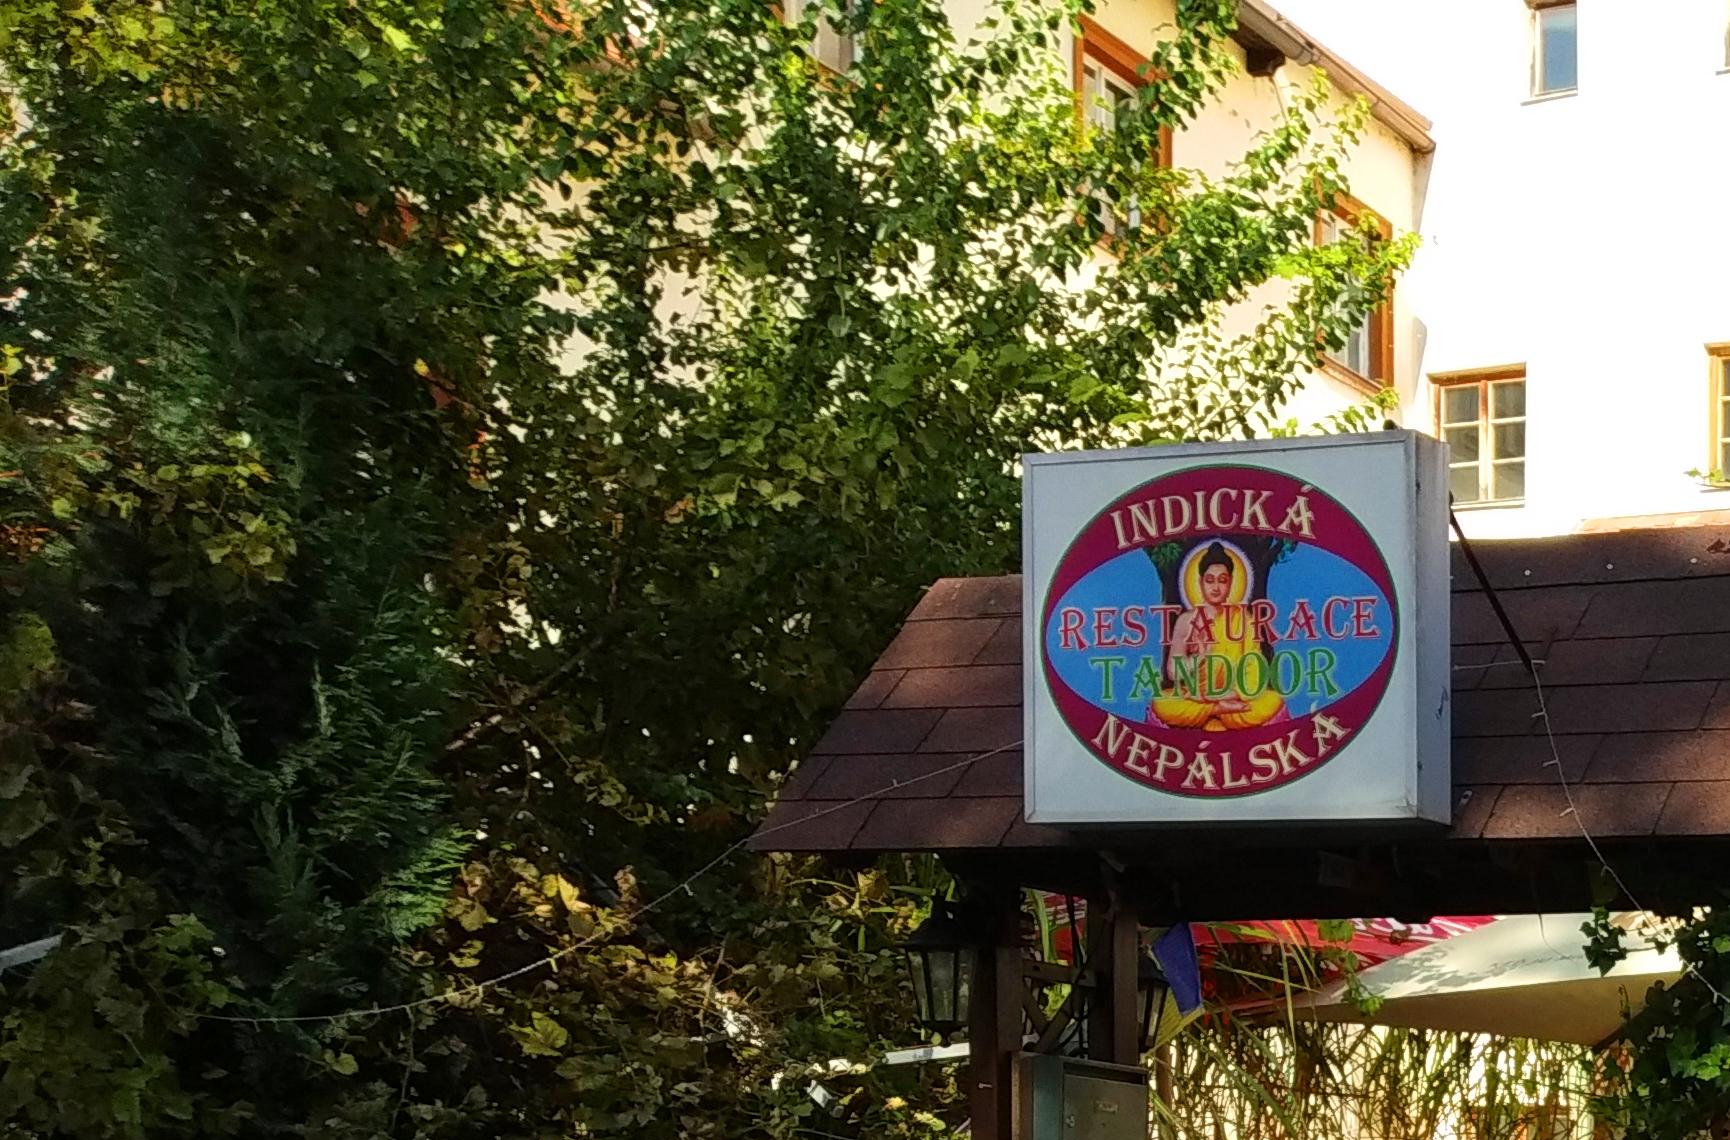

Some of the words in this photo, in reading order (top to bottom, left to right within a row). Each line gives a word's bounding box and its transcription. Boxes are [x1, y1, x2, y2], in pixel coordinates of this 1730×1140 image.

[1109, 484, 1318, 550] INDICKÁ
[1058, 595, 1382, 652] RESTAURACE
[1089, 646, 1341, 702] TANDOOR
[1090, 700, 1353, 791] NEPÁLSKÁ
